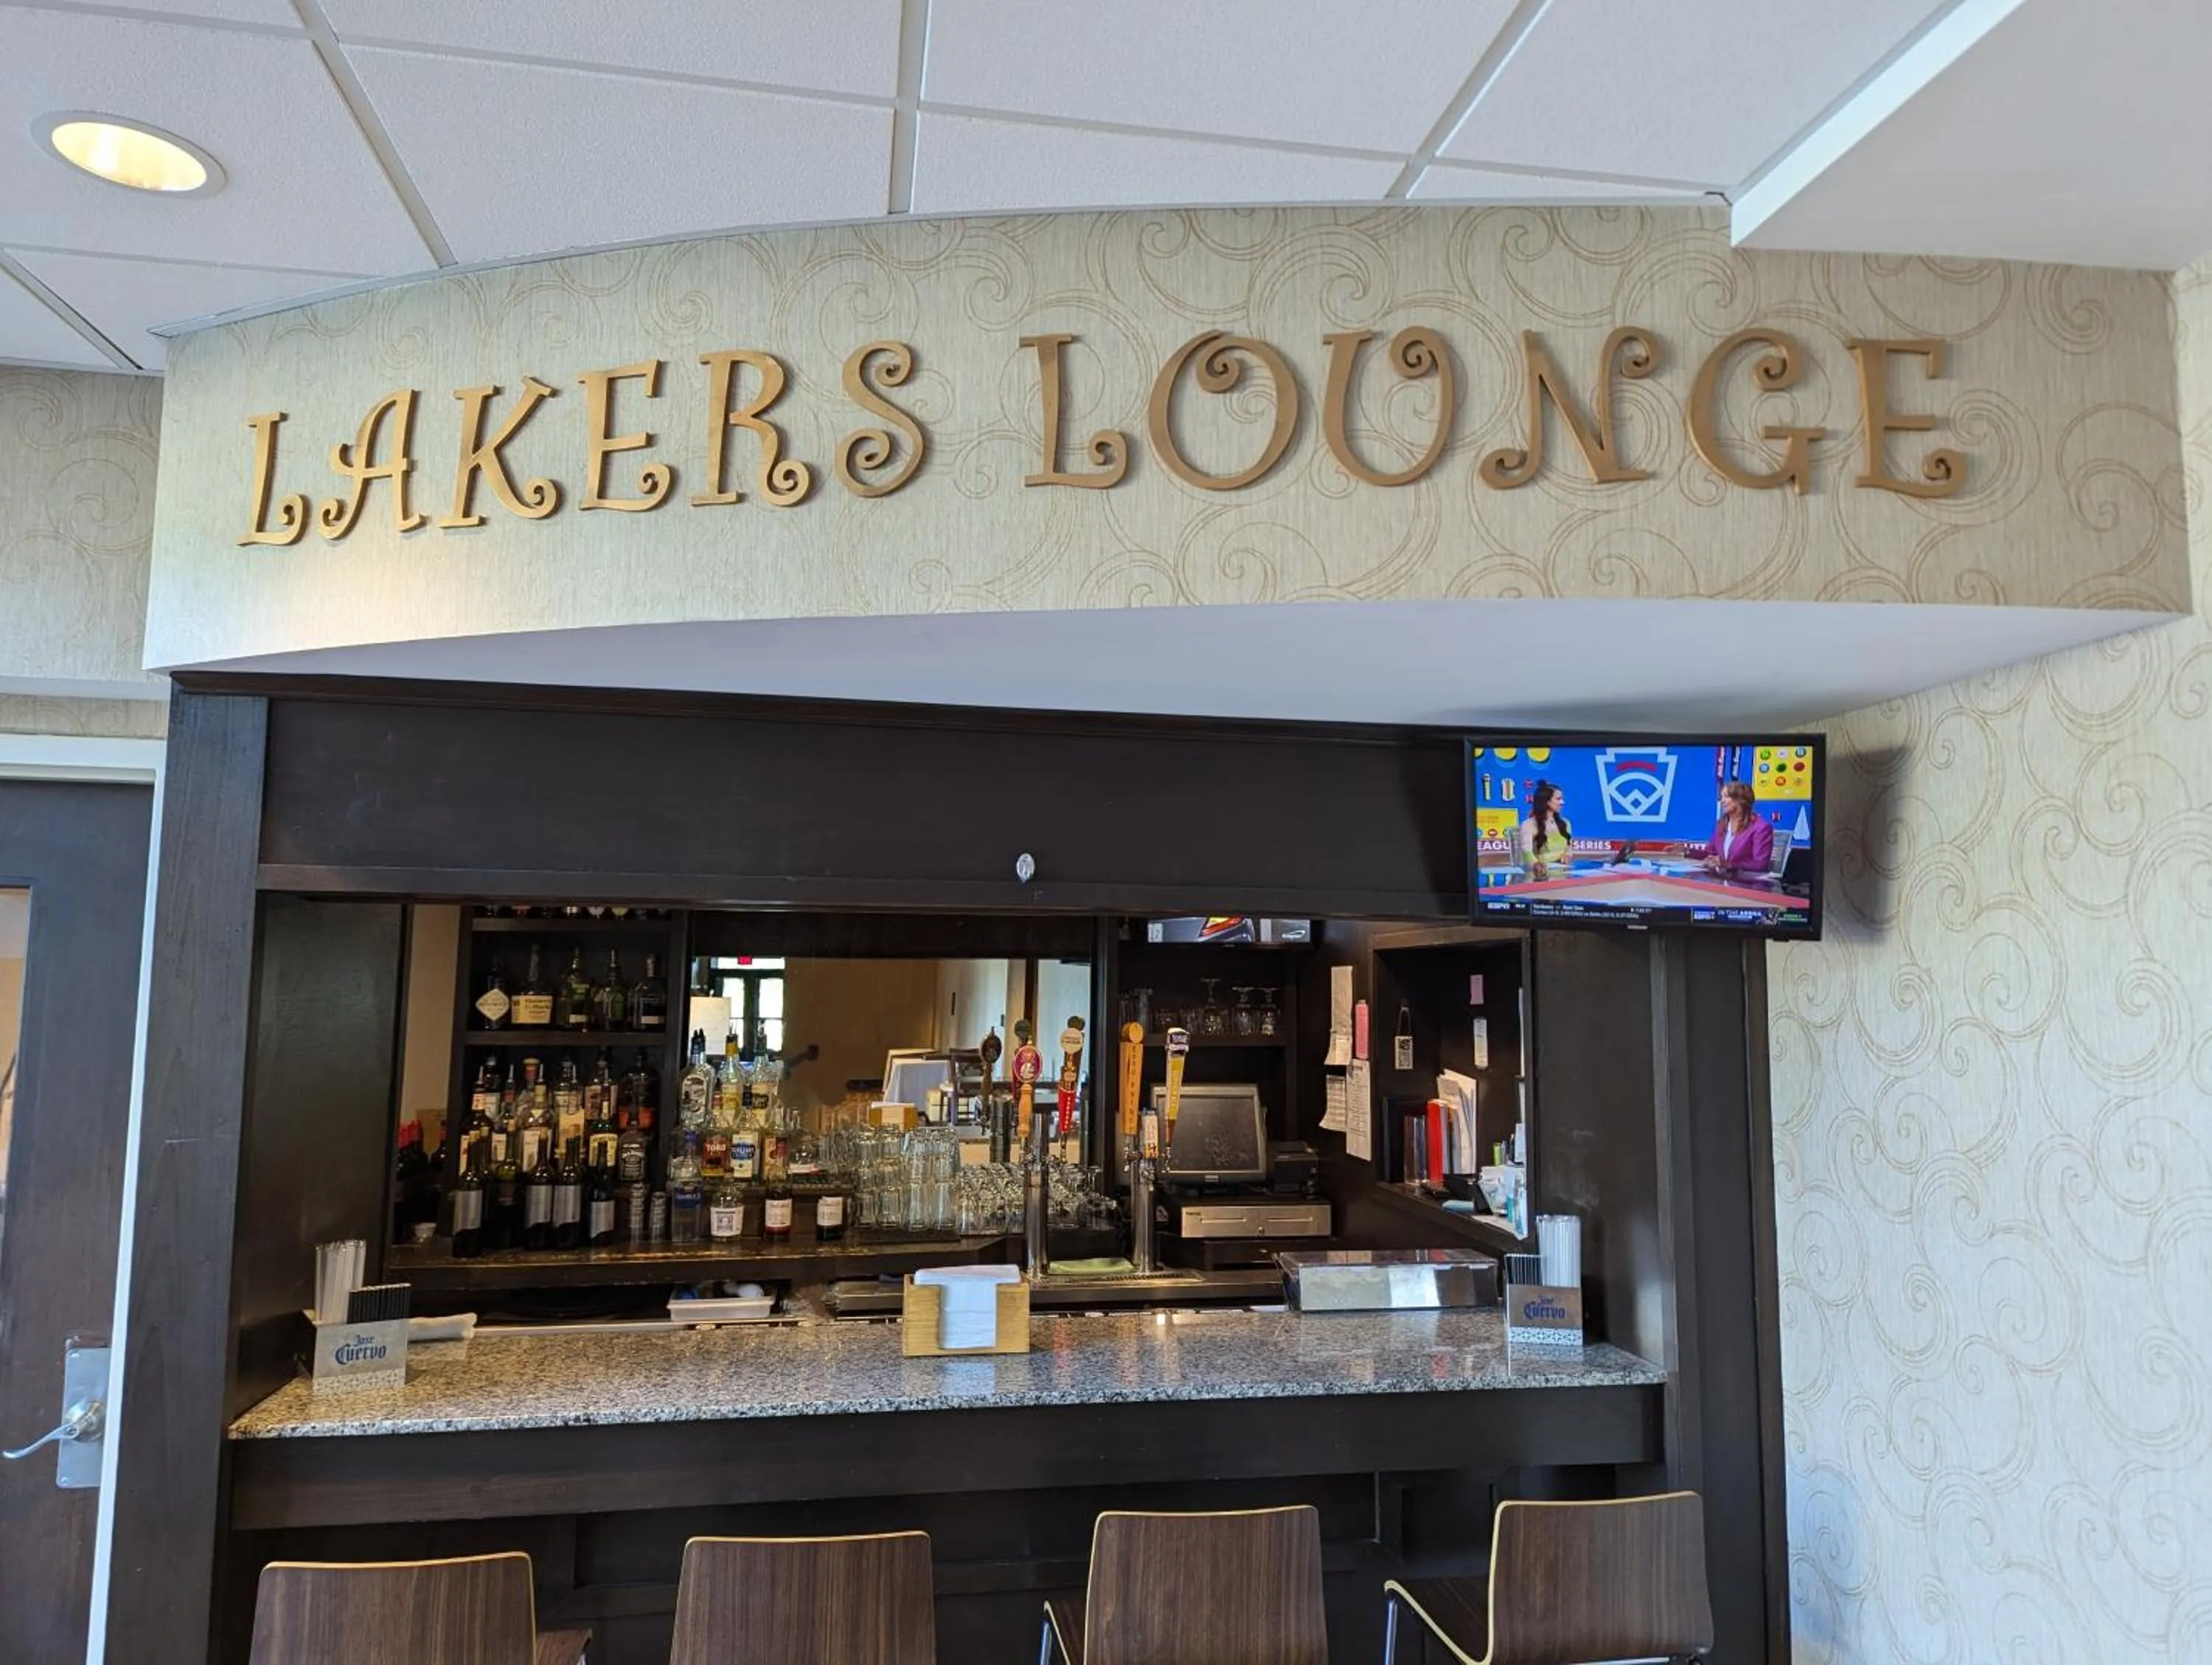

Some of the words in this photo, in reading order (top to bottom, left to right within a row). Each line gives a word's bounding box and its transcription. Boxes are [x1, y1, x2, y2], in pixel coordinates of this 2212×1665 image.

[237, 340, 930, 546] LAKERS
[1019, 326, 1969, 498] LOUNGE
[1572, 840, 1612, 850] SERIES
[1523, 1301, 1565, 1320] Cuervo
[335, 1343, 387, 1365] Cuervo
